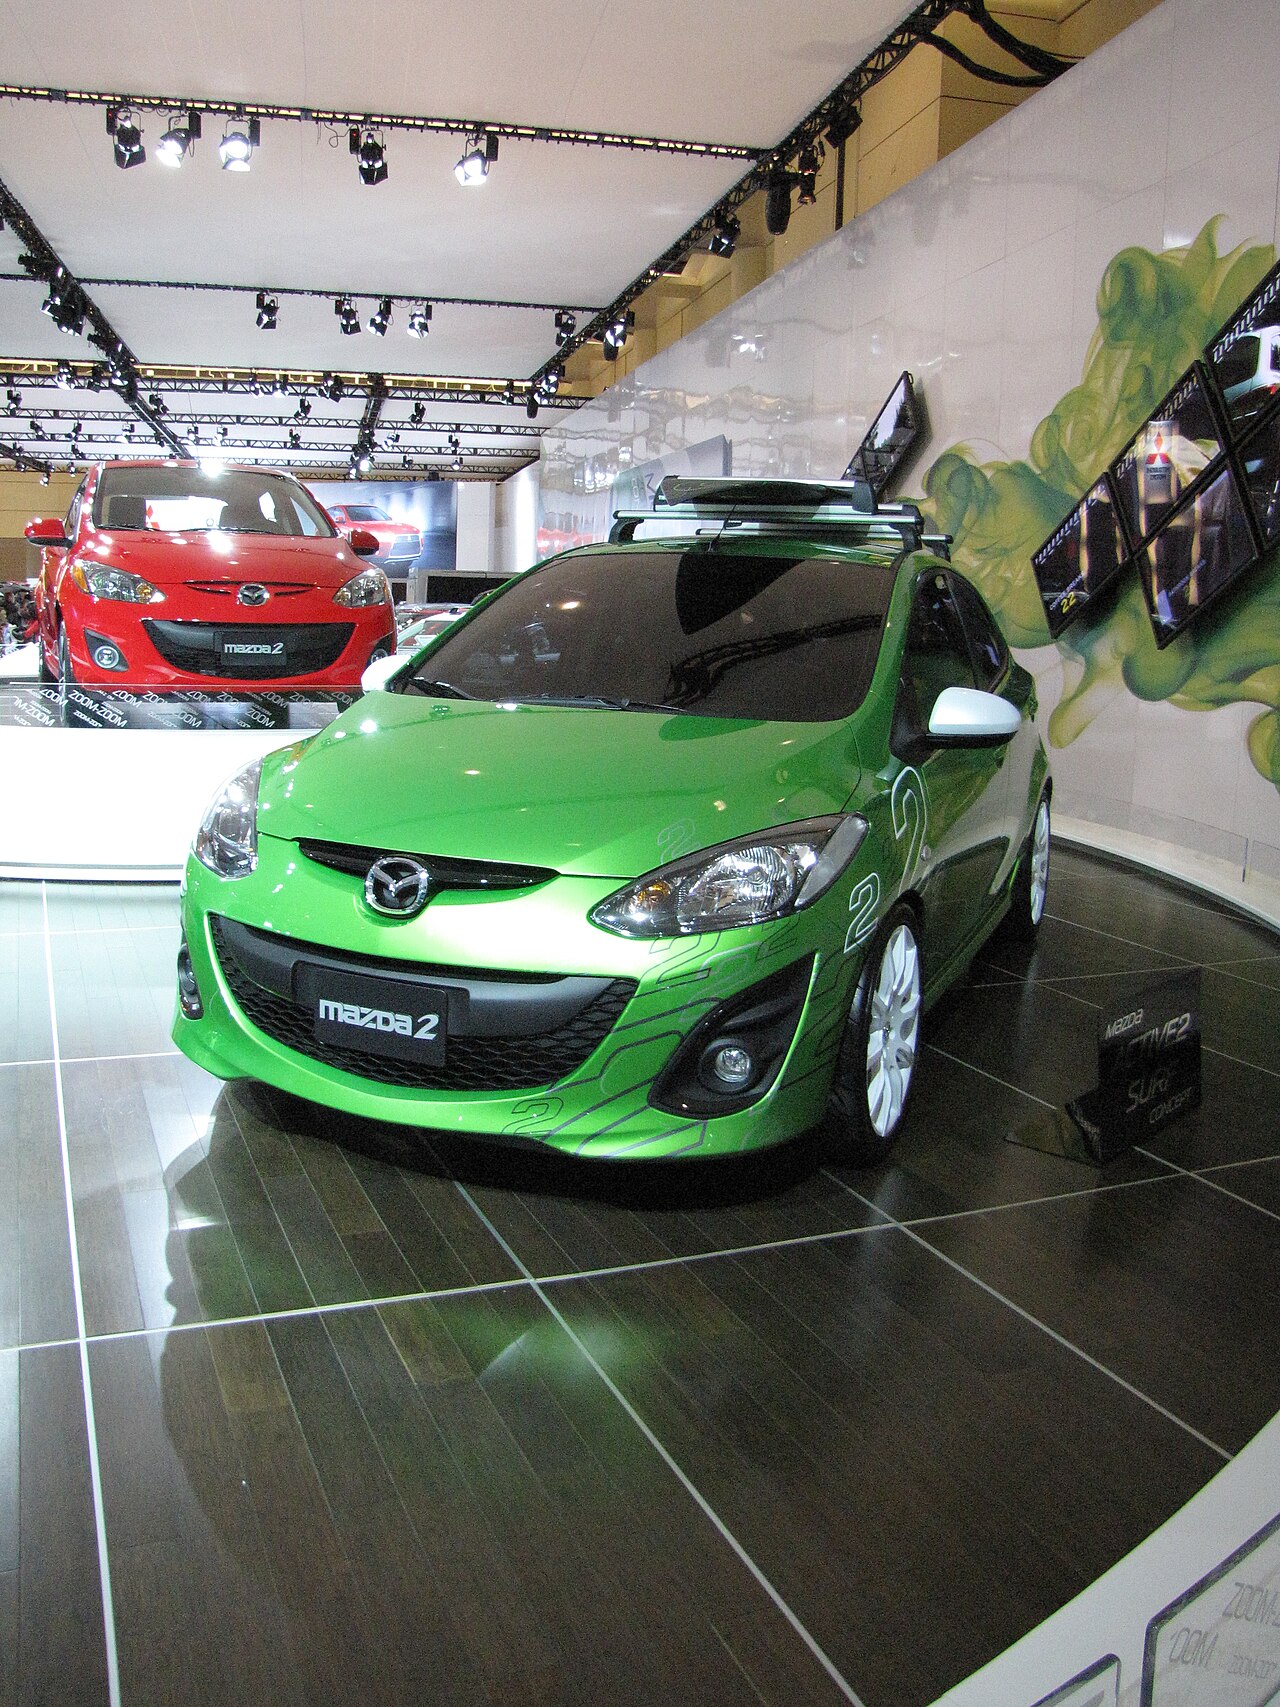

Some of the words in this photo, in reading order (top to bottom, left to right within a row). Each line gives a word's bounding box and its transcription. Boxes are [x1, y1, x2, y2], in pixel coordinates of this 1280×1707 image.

[1060, 591, 1076, 614] 22
[68, 689, 128, 727] ZOOM-ZOOM
[142, 690, 168, 704] ZOO
[245, 708, 276, 728] ZOOM
[844, 872, 880, 954] 2
